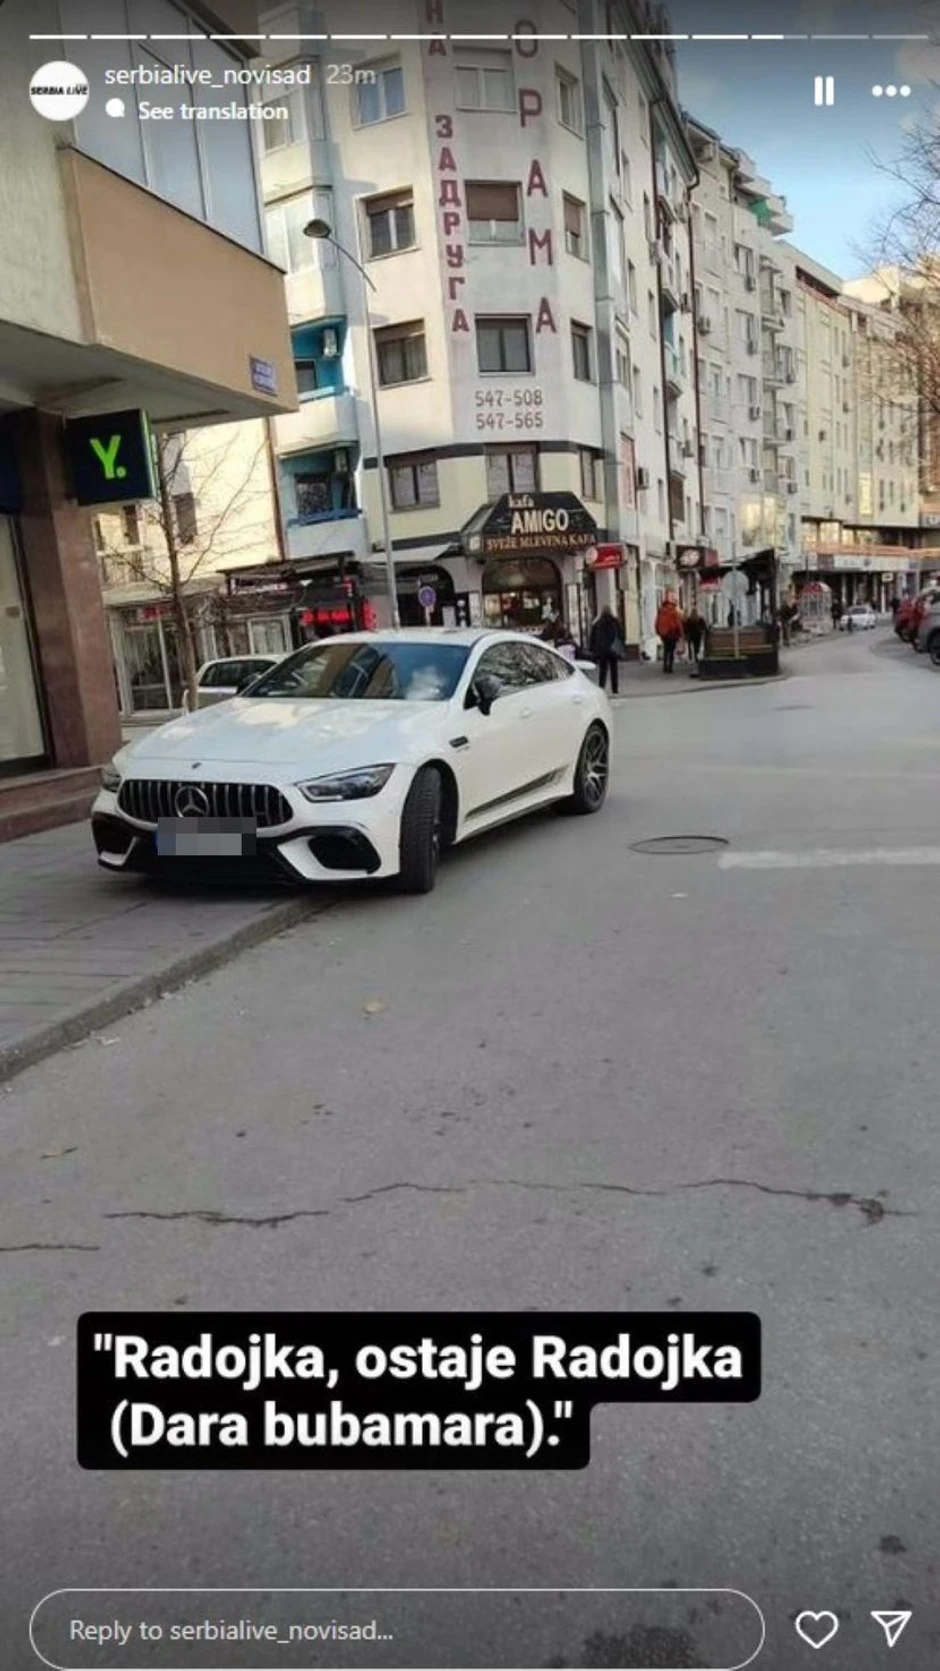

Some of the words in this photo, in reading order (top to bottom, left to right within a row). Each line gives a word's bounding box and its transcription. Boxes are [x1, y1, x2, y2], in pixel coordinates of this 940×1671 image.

[514, 19, 557, 334] ОРАМА
[435, 114, 470, 333] ЗАДРУГА
[475, 389, 543, 407] 547-508
[476, 411, 544, 430] 547-565
[511, 508, 569, 534] AMIGO
